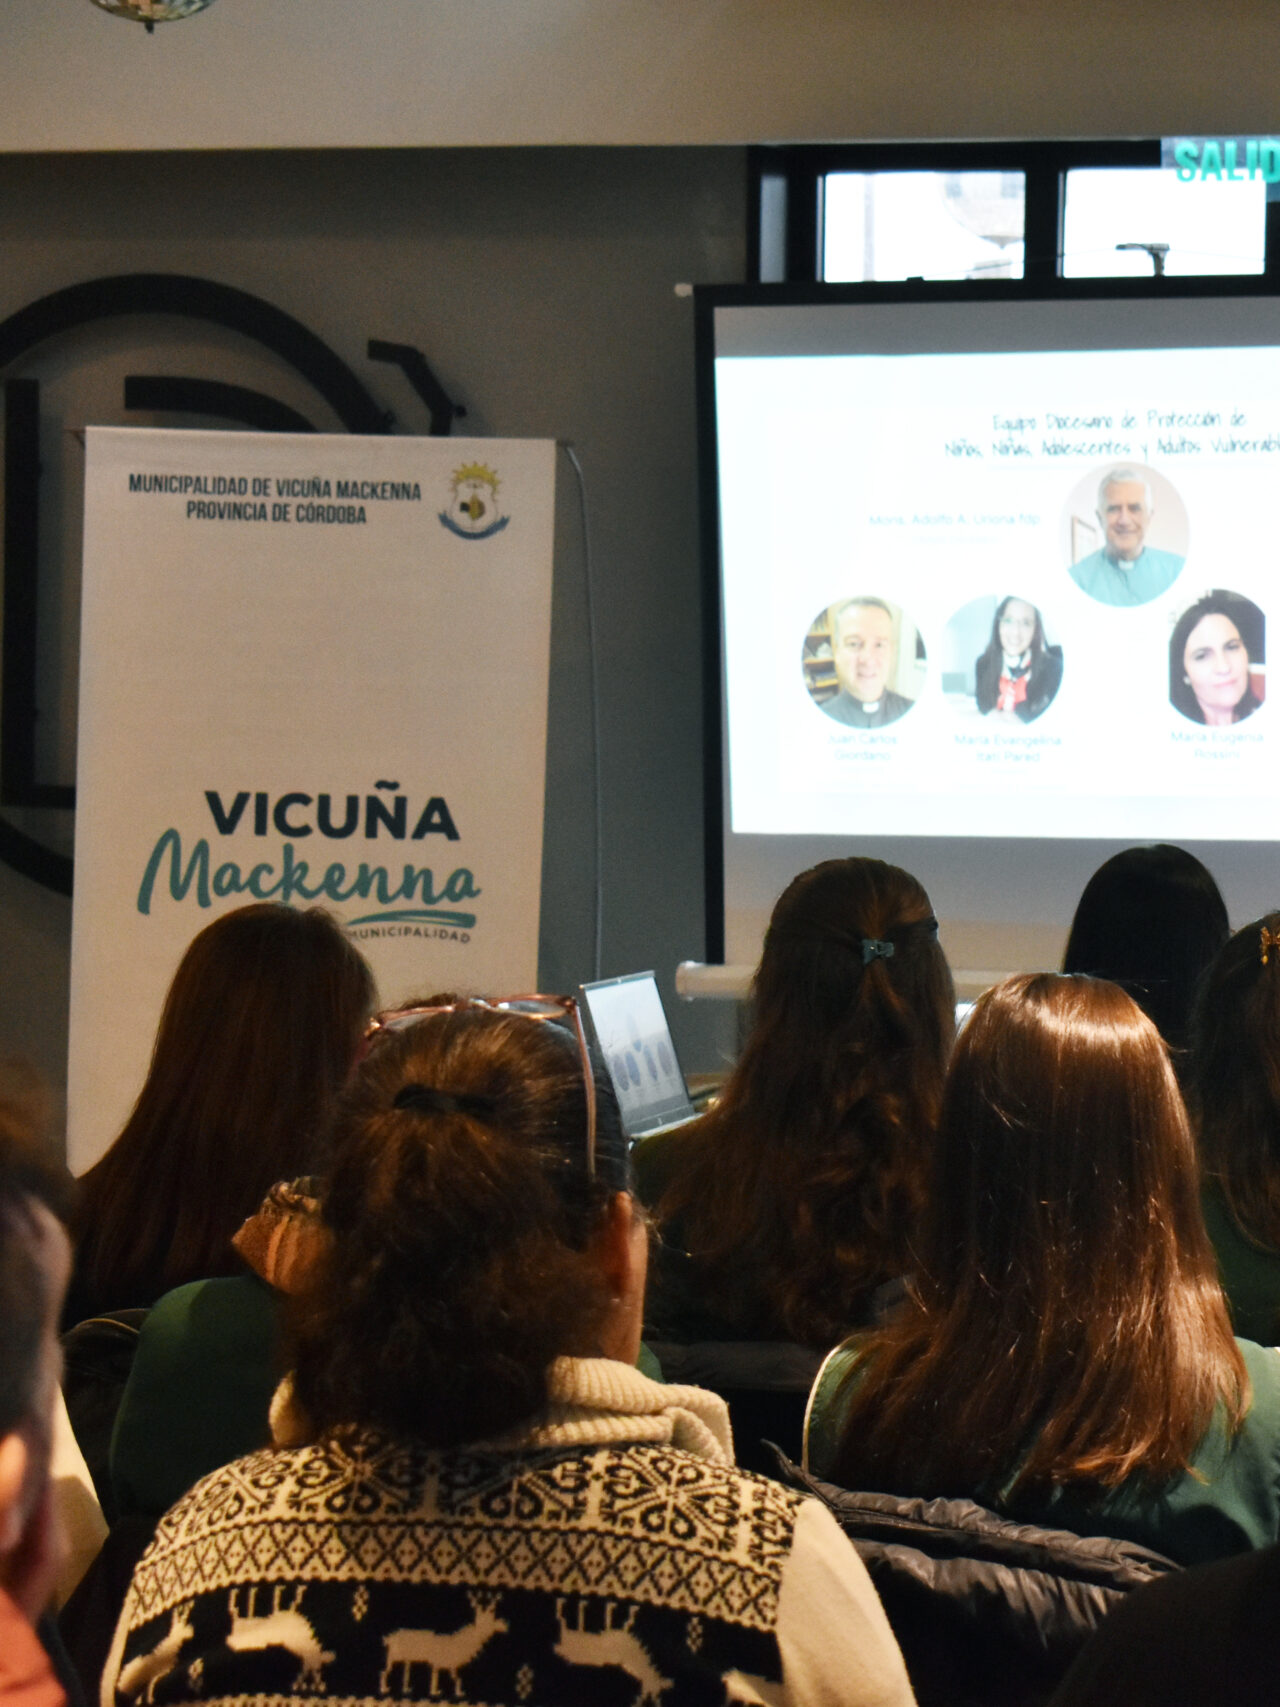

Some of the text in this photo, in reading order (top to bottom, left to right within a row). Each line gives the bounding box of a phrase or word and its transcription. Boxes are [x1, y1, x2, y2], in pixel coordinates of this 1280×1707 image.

[992, 413, 1037, 435] Equipo
[1046, 412, 1113, 430] Diocesano
[1121, 409, 1137, 429] de
[1230, 406, 1247, 427] de
[1041, 436, 1131, 456] Adolescentes
[1140, 443, 1149, 463] y
[1156, 433, 1202, 455] Adultos
[128, 473, 423, 501] MUNICIPALIDAD DE VICUÑA MACKENNA
[186, 499, 368, 524] PROVINCIA DE CÓRDOBA
[204, 780, 461, 841] VICUÑA
[136, 828, 482, 915] Mackenna
